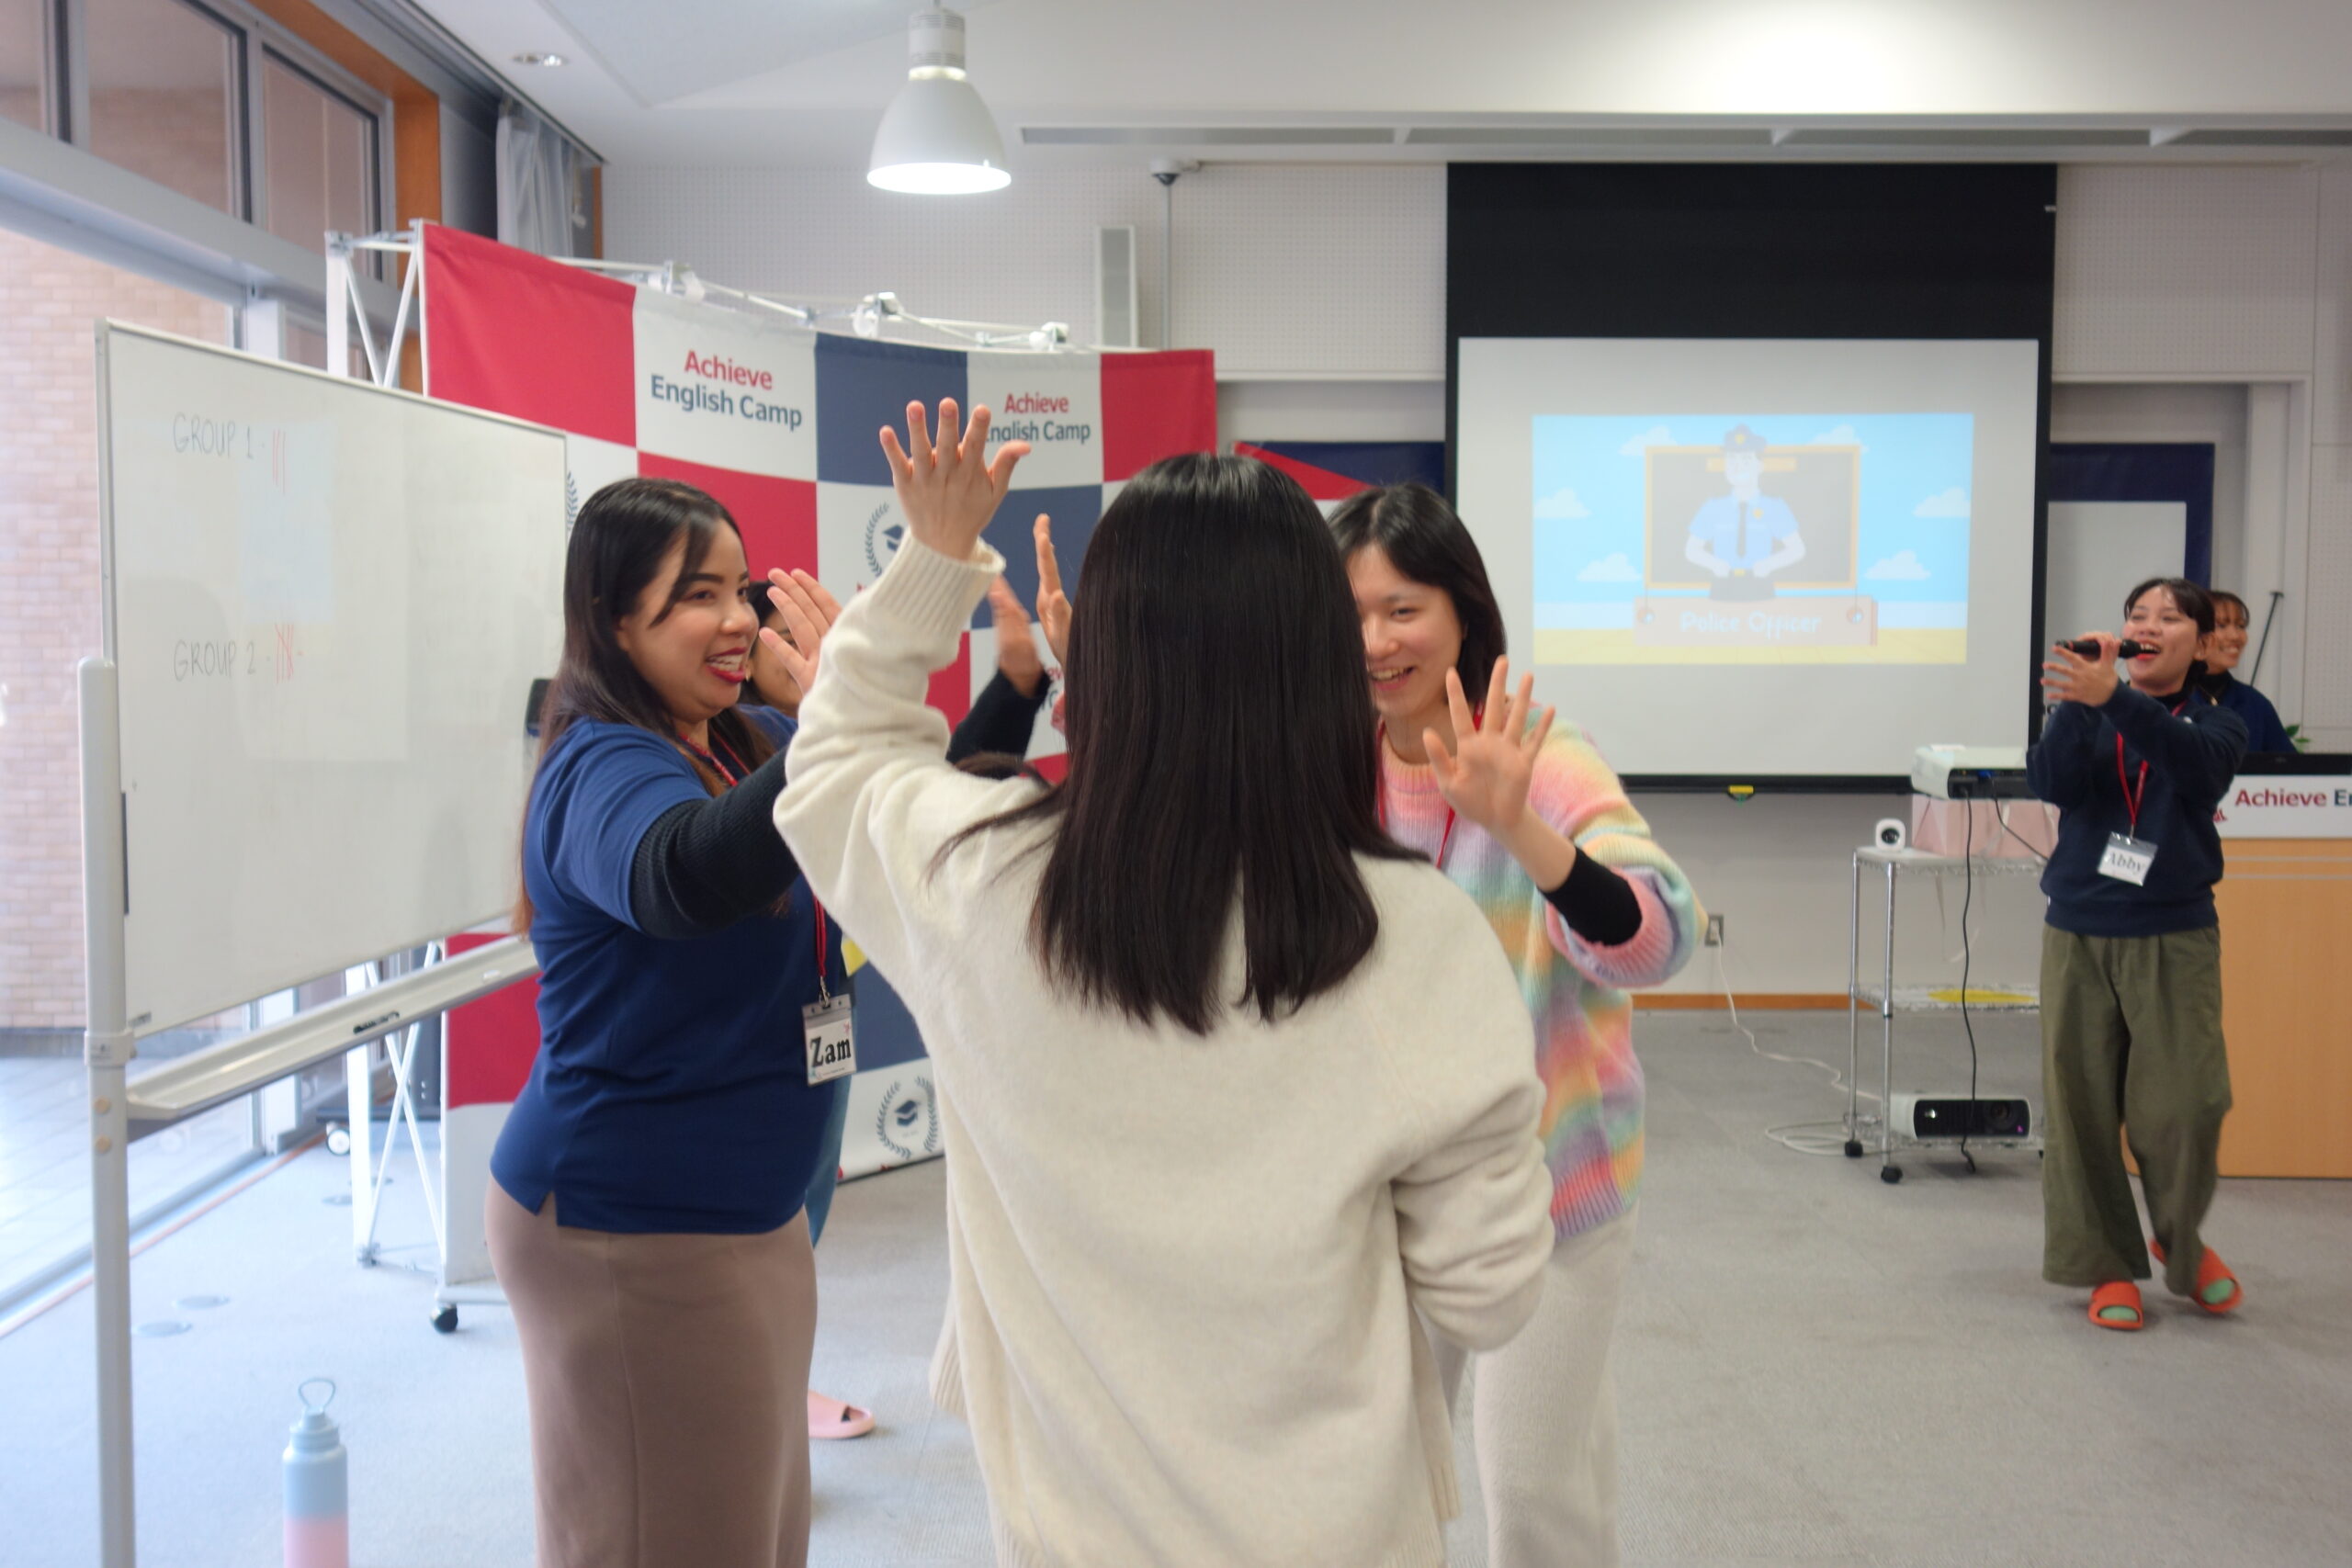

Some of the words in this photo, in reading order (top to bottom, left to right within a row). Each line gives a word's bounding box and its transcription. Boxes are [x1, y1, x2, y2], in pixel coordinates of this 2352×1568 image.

[684, 350, 773, 390] Achieve
[650, 374, 734, 415] English
[739, 395, 802, 432] Camp
[1004, 392, 1069, 413] Achieve
[173, 411, 236, 459] GROUP
[245, 424, 254, 459] 1
[986, 421, 1039, 443] nglish
[1044, 421, 1091, 445] Camp
[1679, 610, 1741, 633] Police
[1748, 610, 1823, 639] Officer
[173, 639, 237, 682] GROUP
[246, 640, 256, 675] 2
[2234, 788, 2327, 807] Achieve
[2334, 788, 2352, 807] E
[810, 1036, 851, 1067] Zam
